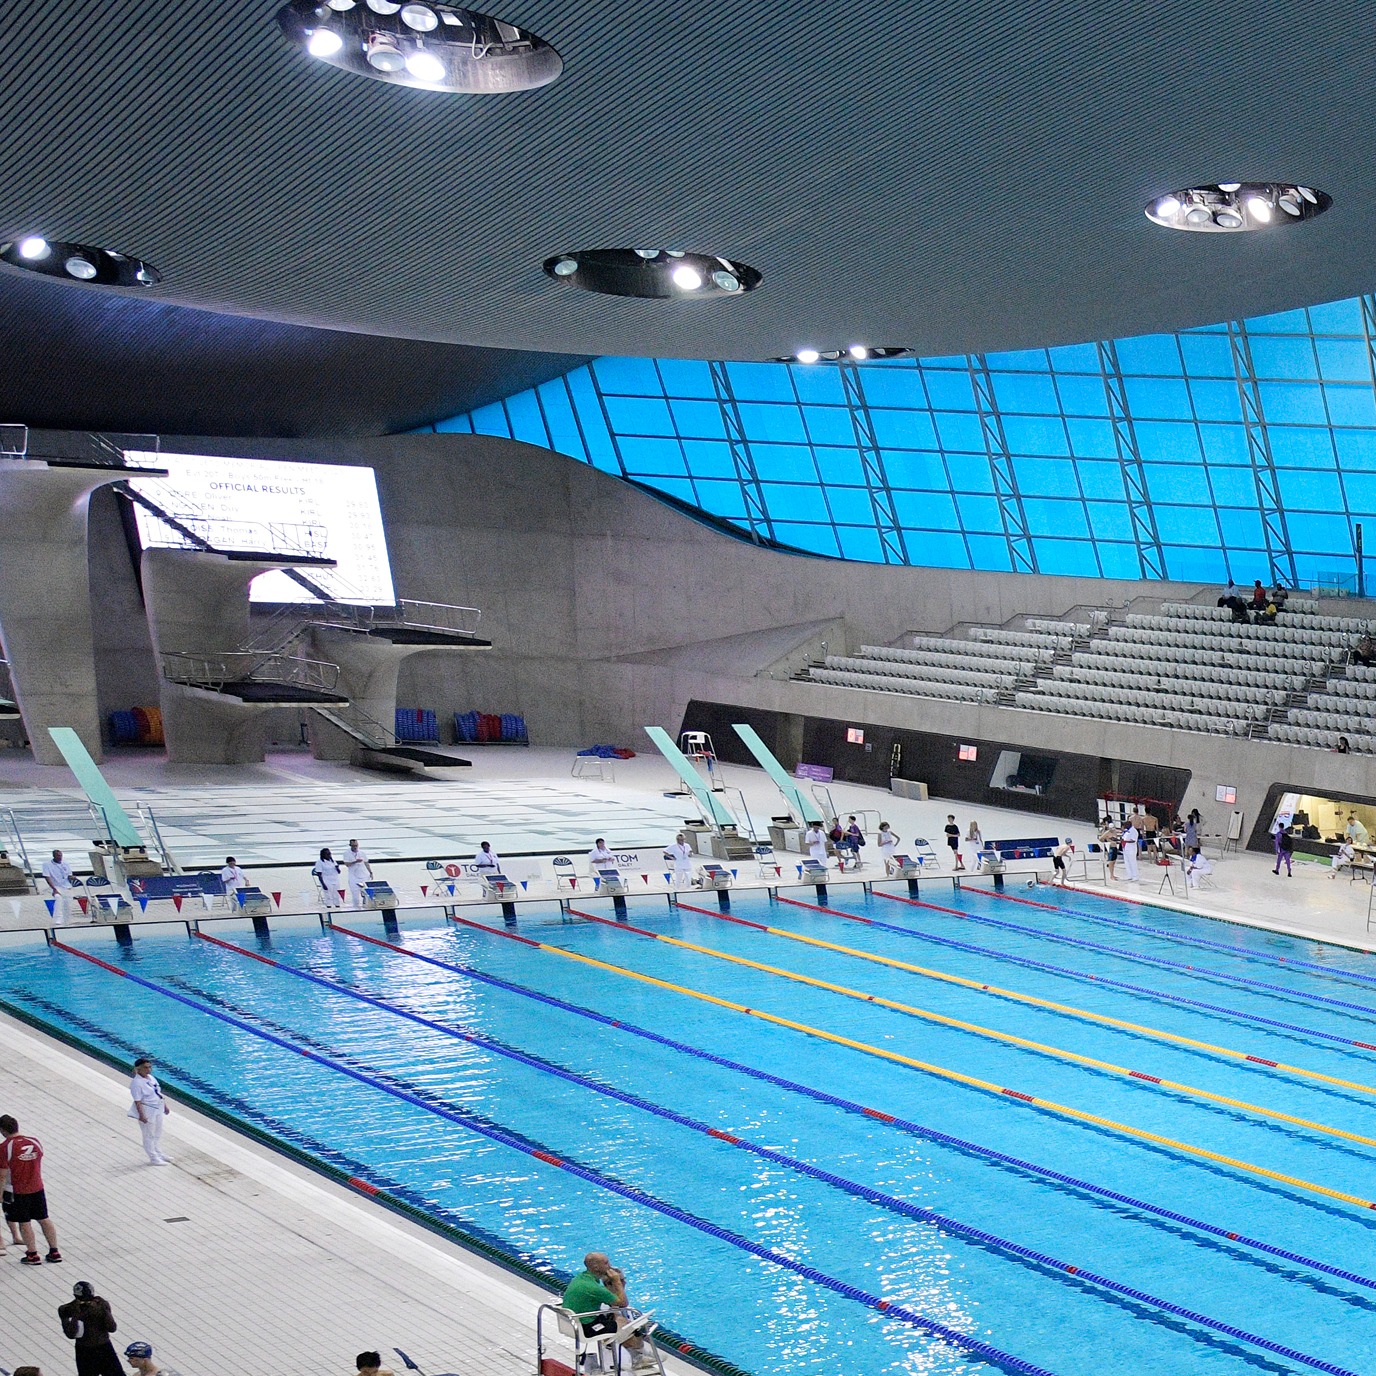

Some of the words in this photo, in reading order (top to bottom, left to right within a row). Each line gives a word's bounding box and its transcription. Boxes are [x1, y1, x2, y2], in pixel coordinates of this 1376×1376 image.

[209, 481, 259, 493] OFFICIAL
[261, 485, 306, 495] RESULTS
[204, 492, 232, 500] Oliver
[300, 509, 322, 517] KIRL
[220, 525, 258, 535] Thomas
[613, 854, 639, 863] TOM
